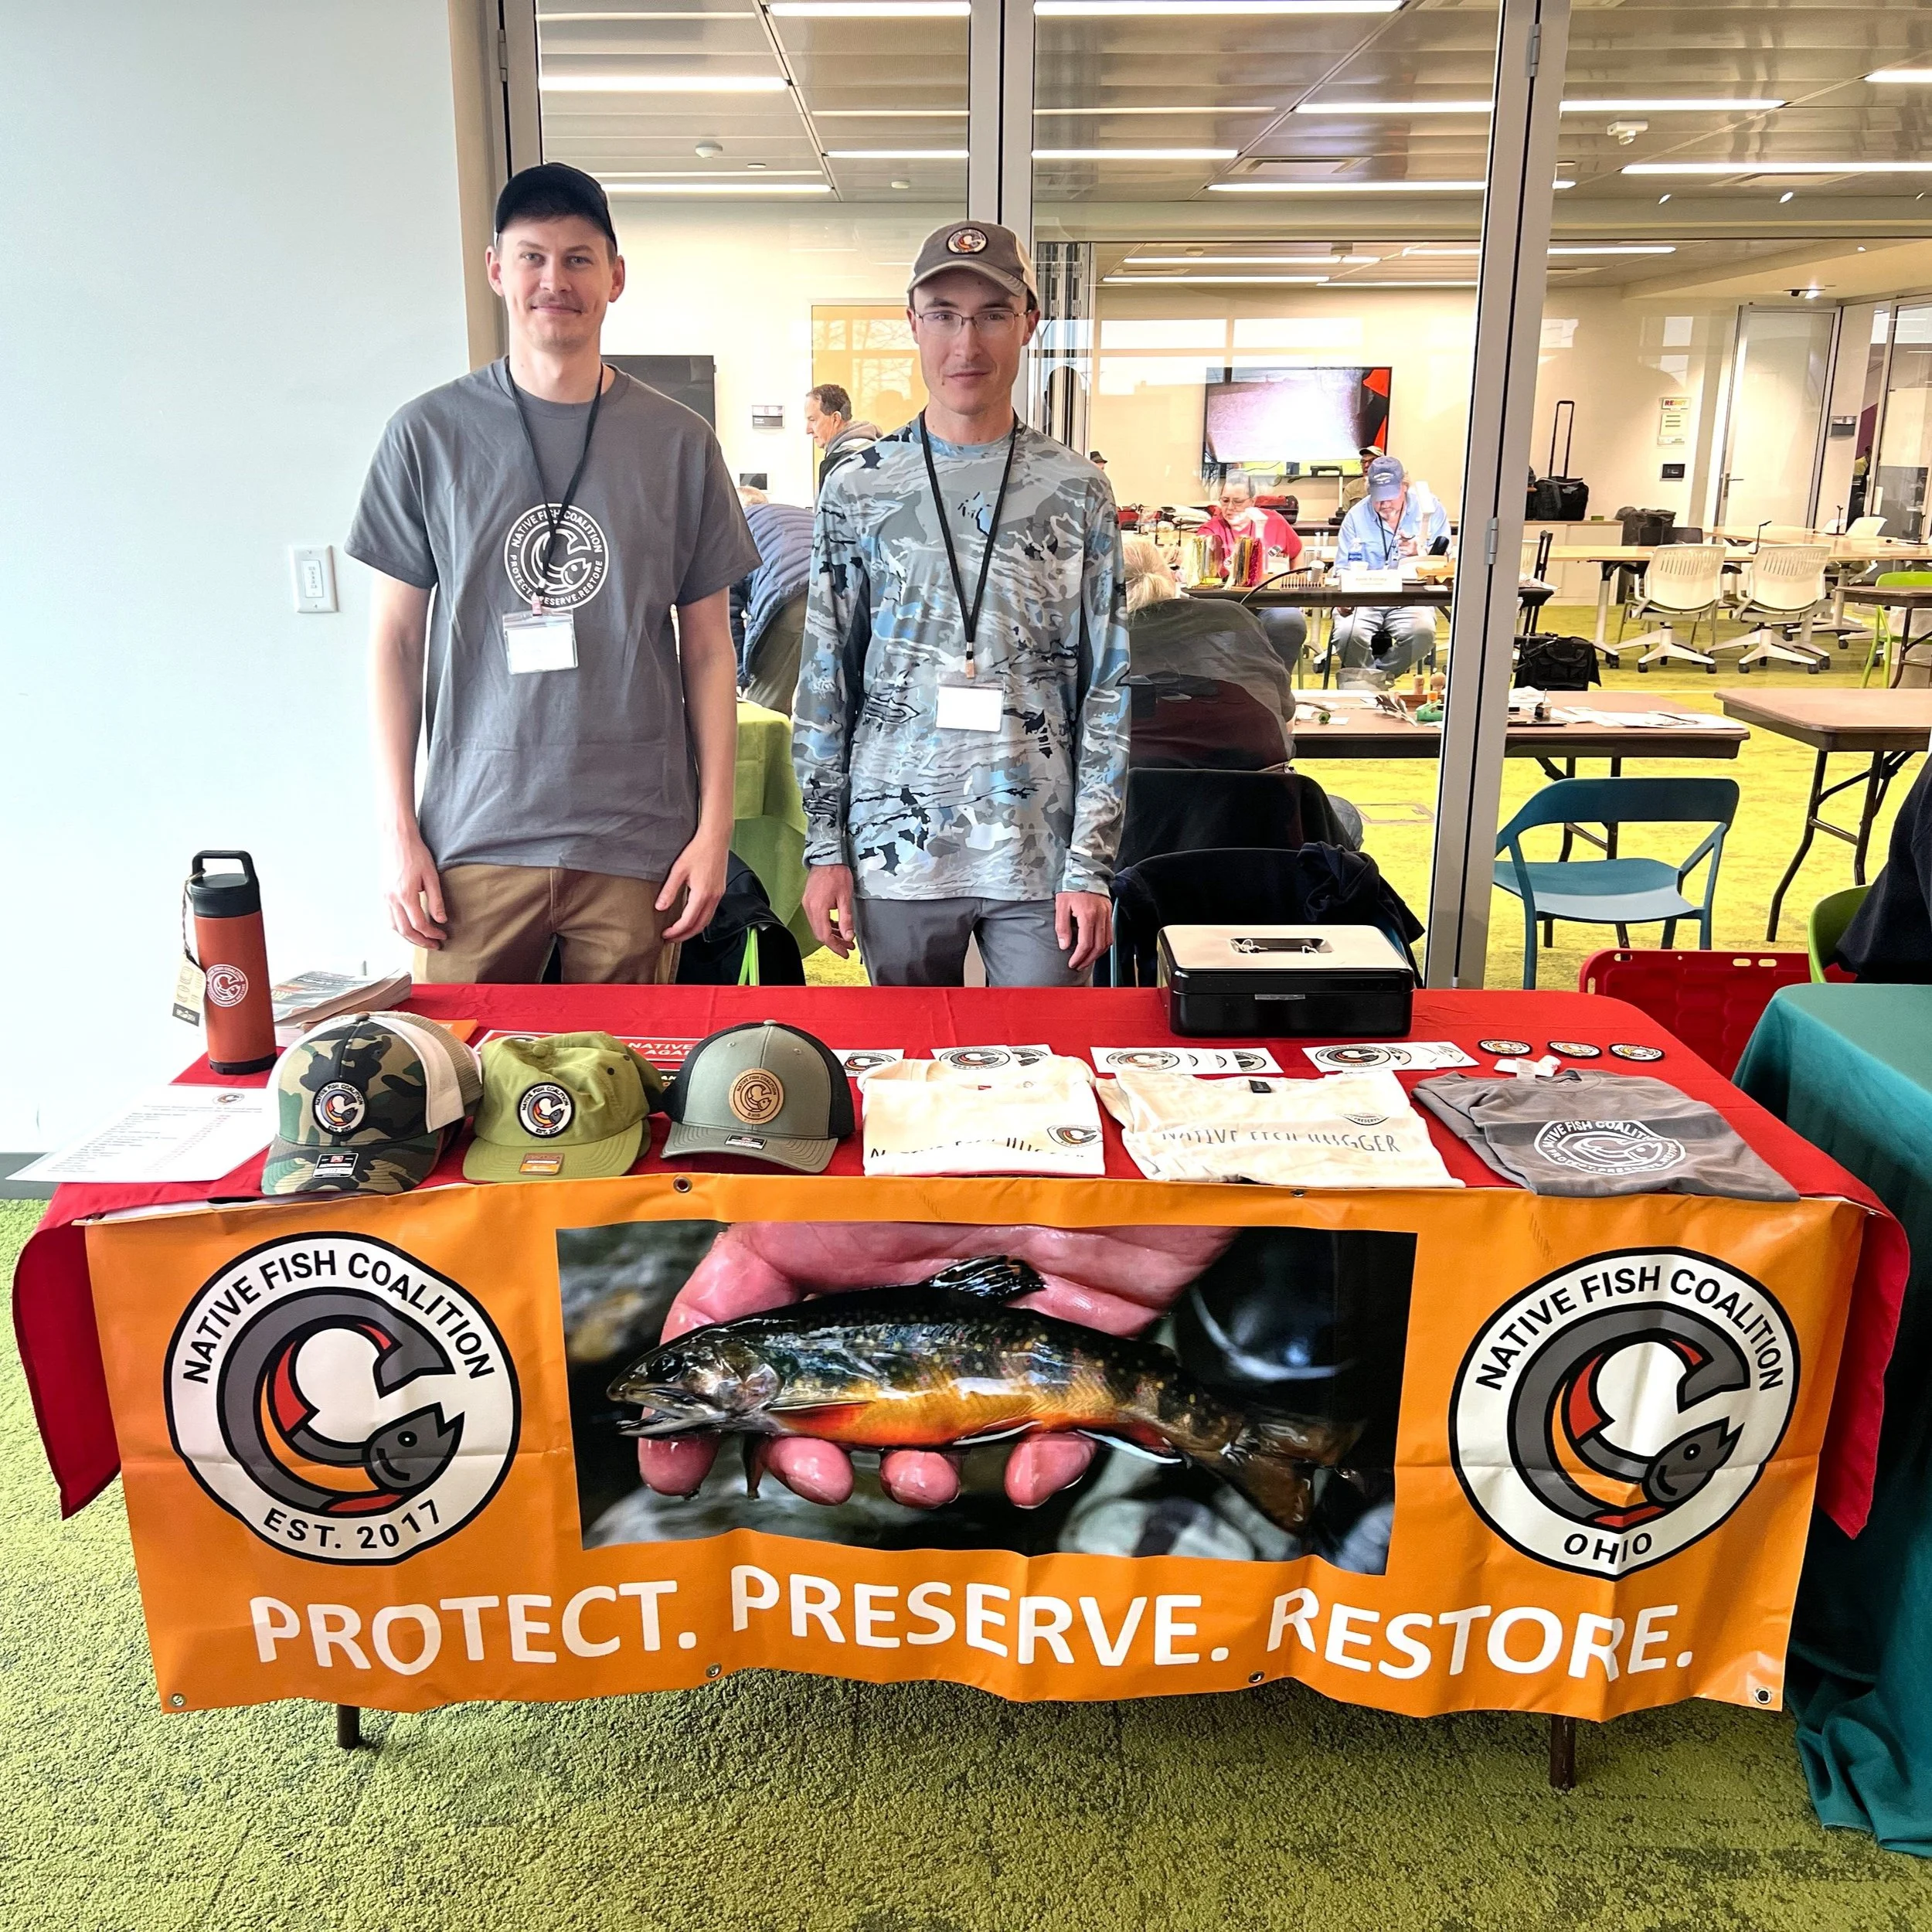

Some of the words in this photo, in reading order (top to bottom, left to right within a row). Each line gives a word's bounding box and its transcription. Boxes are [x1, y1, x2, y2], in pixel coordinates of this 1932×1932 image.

[512, 515, 539, 548] NATIVE
[563, 510, 603, 553] COALITION
[539, 594, 580, 607] RESERVE.
[580, 560, 603, 599] RESTORE
[627, 1042, 694, 1050] NATIVE
[340, 1083, 363, 1106] COALITION
[522, 1093, 533, 1111] NATIVE
[546, 1086, 570, 1107] COALITION
[736, 1077, 749, 1092] NATIVE
[760, 1076, 777, 1096] COALITION
[1564, 1120, 1594, 1132] FISH
[182, 1276, 260, 1384] NATIVE
[259, 1250, 337, 1290] FISH
[348, 1253, 495, 1380] COALITION
[1475, 1287, 1577, 1391] NATIVE
[1580, 1265, 1662, 1304] FISH
[1670, 1268, 1784, 1392] COALITION
[263, 1507, 342, 1549] EST.
[356, 1498, 440, 1549] 2017
[1563, 1532, 1652, 1565] OHIO
[249, 1580, 698, 1676] PROTECT.
[730, 1564, 1230, 1667] PRESERVE.
[1266, 1587, 1694, 1682] RESTORE.
